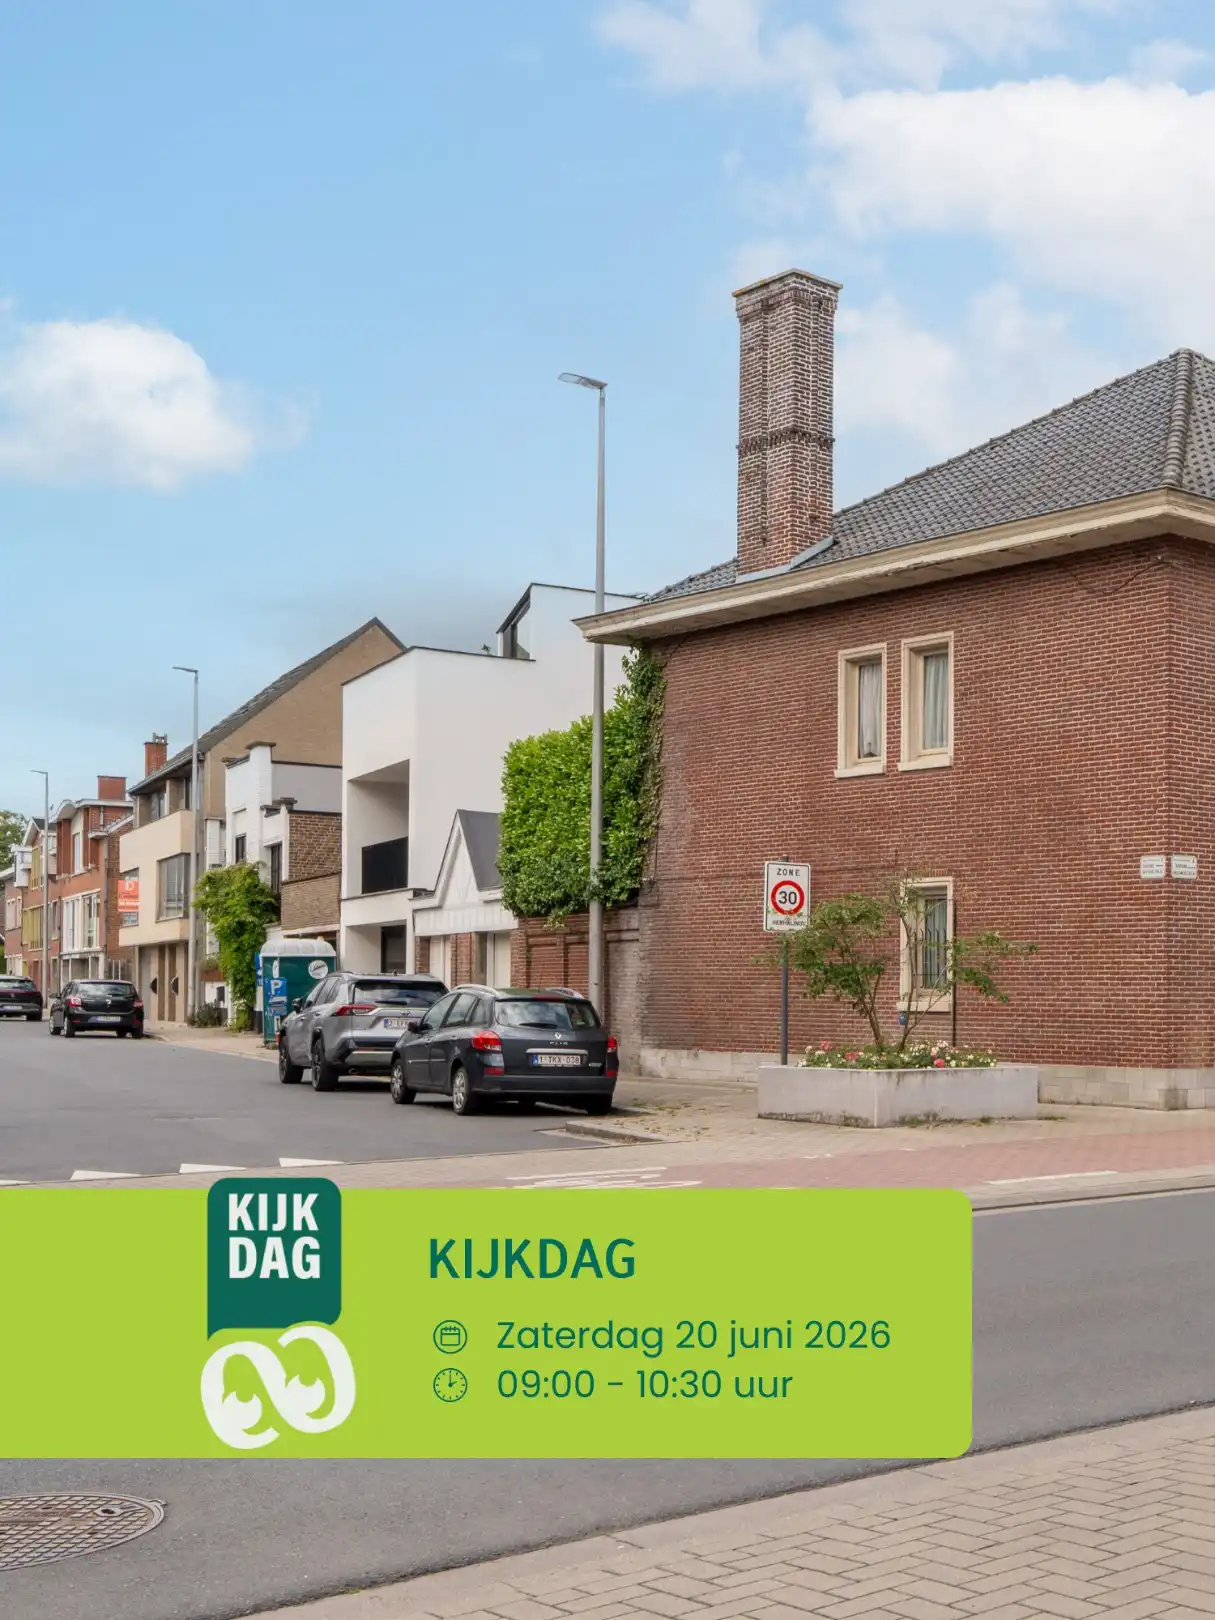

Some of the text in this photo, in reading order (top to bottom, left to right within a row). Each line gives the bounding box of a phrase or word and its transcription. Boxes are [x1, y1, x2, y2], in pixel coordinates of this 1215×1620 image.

[776, 868, 800, 877] ZONE
[778, 890, 797, 905] 30
[540, 1056, 580, 1064] 1-TKX-038
